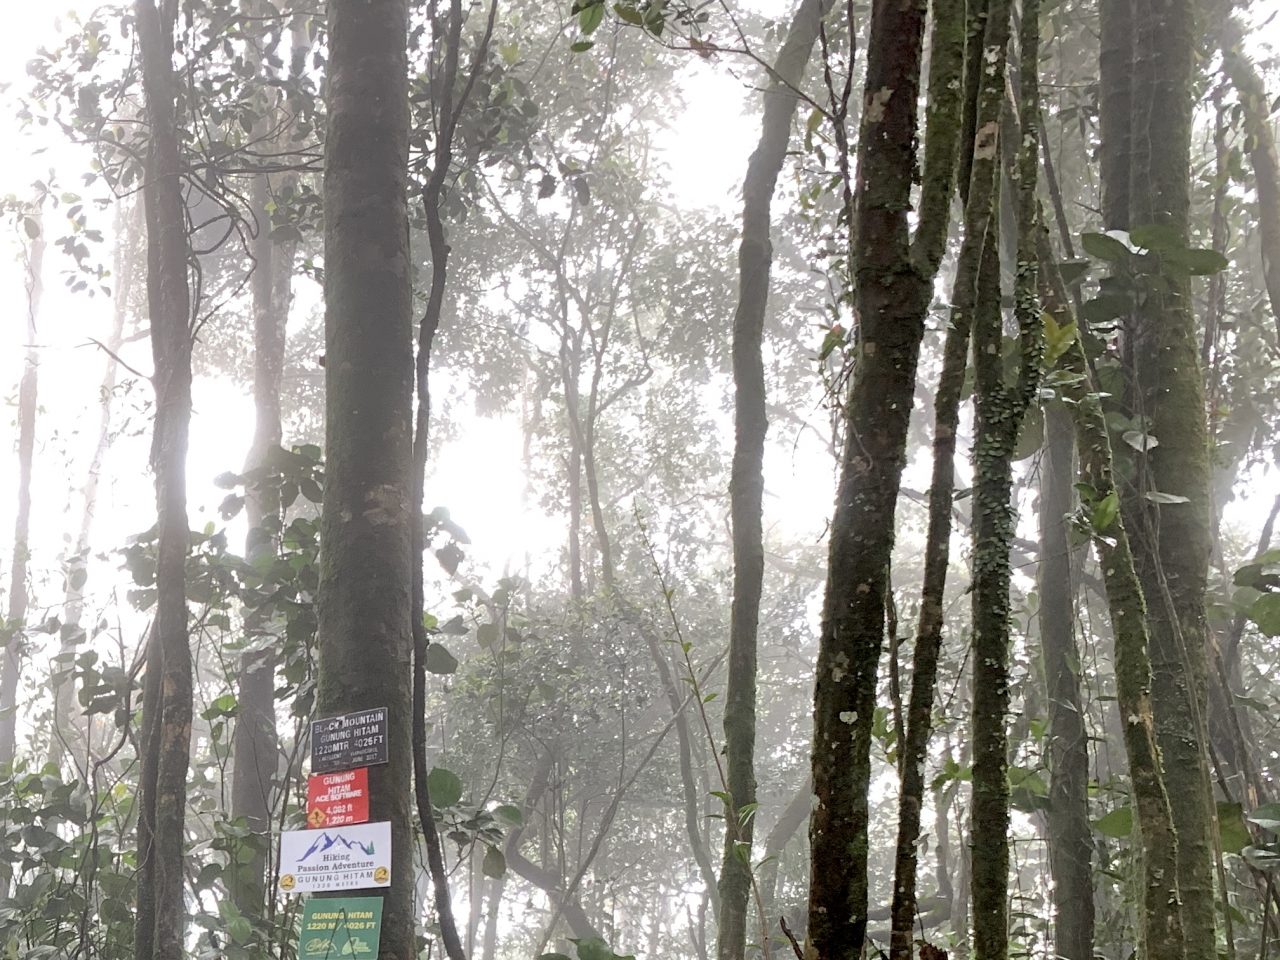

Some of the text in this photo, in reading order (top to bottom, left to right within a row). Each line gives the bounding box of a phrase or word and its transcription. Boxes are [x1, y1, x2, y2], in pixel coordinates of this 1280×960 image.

[342, 712, 384, 728] MOUNTAIN
[320, 724, 379, 743] GUNUNG HITAM
[323, 772, 355, 785] GUNUNG
[328, 784, 351, 795] HITAM
[315, 789, 362, 803] ACE SOFTWARE
[323, 853, 351, 862] Hiking
[297, 861, 374, 873] Passion Adventure
[298, 871, 373, 883] GUNUNG HITAM
[312, 911, 374, 920] GUNUNG HITAM
[306, 922, 326, 930] 1220
[327, 922, 336, 930] M
[343, 921, 365, 930] 4026
[366, 921, 376, 929] FT
